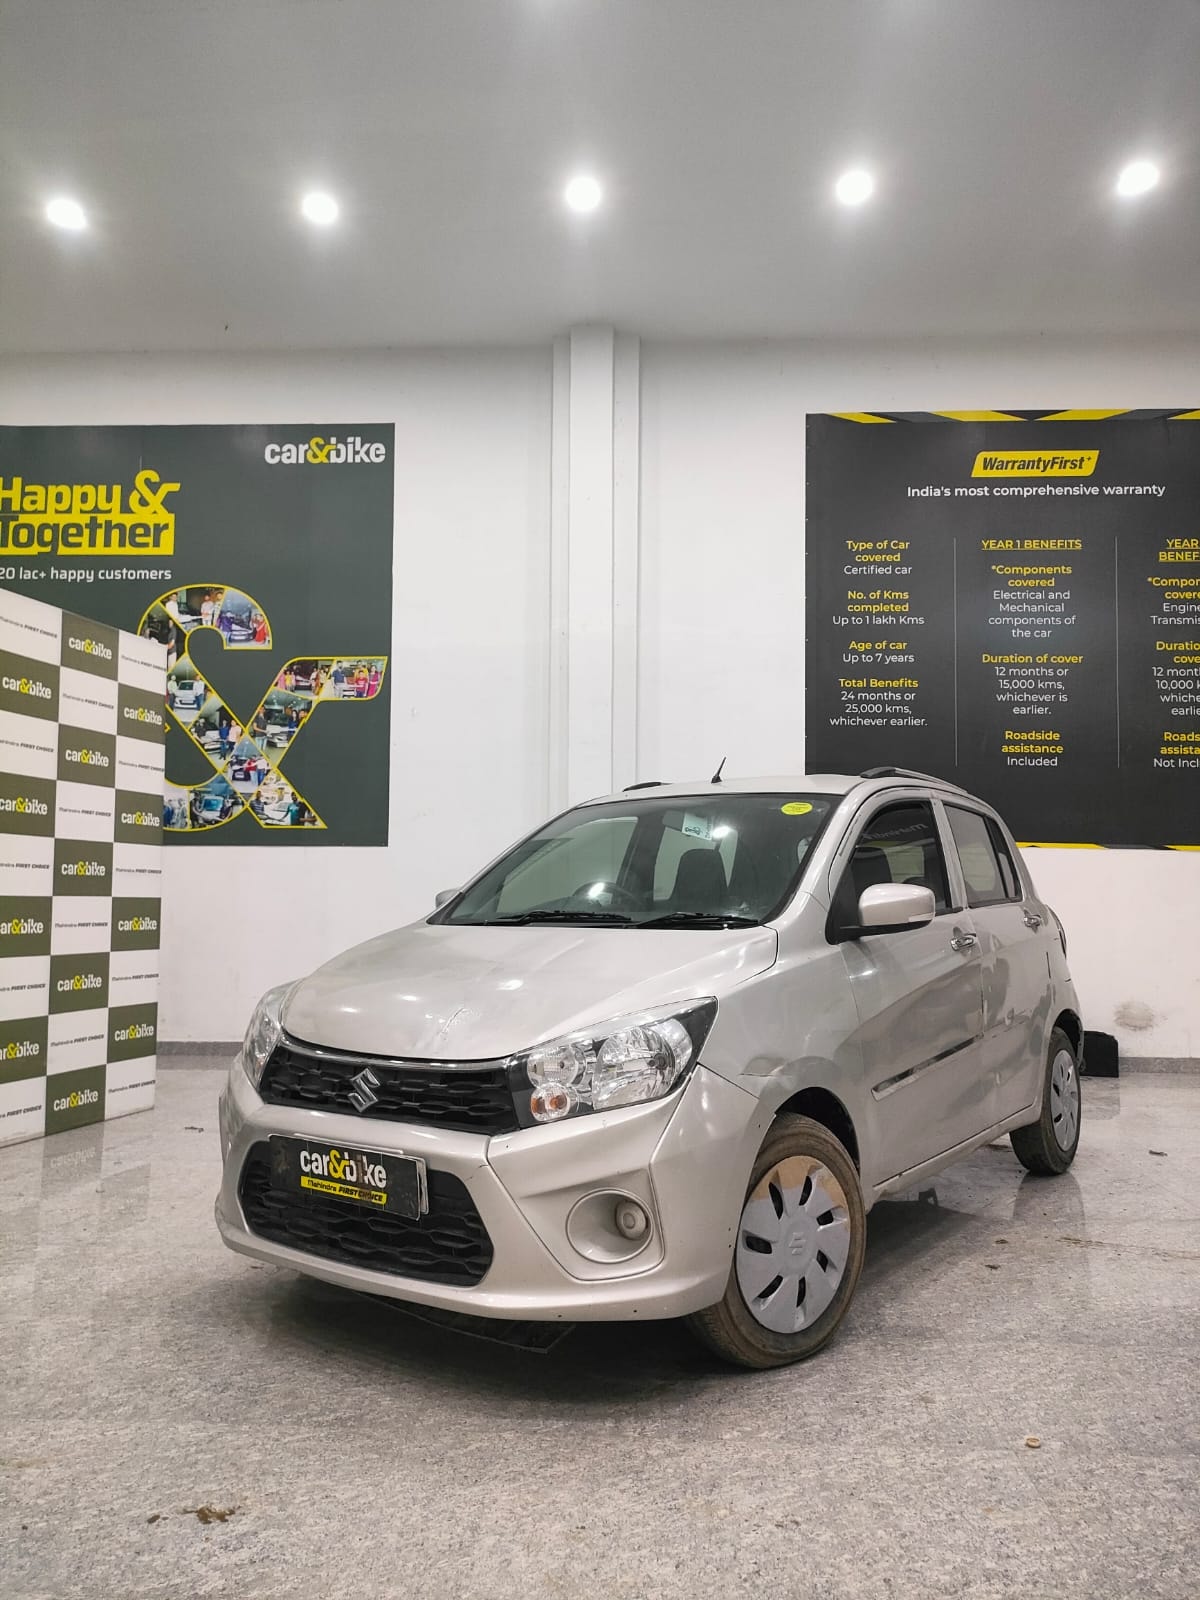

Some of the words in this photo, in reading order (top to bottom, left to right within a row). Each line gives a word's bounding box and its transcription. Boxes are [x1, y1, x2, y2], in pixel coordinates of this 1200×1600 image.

[264, 436, 386, 465] car&bike
[0, 476, 122, 514] Happy
[129, 469, 181, 514] &
[907, 485, 952, 497] India's
[954, 486, 990, 497] most
[992, 483, 1100, 498] comprehensive
[1102, 484, 1166, 497] warranty
[0, 516, 169, 555] Together
[846, 540, 873, 552] Type
[876, 540, 888, 550] of
[890, 539, 911, 550] Car
[981, 539, 1014, 549] YEAR
[1023, 539, 1082, 549] BENEFITS
[1166, 538, 1199, 549] YEAR
[855, 552, 901, 562] covered
[19, 566, 47, 580] lac+
[51, 566, 94, 582] happy
[98, 567, 172, 580] customers
[843, 564, 892, 575] Certified
[894, 566, 913, 575] car
[1007, 577, 1055, 587] covered
[847, 590, 866, 600] No.
[869, 590, 880, 600] of
[883, 590, 909, 600] Kms
[993, 589, 1045, 600] Electrical
[1047, 590, 1071, 600] and
[847, 602, 909, 614] completed
[999, 602, 1065, 613] Mechanical
[832, 615, 849, 627] Up
[851, 616, 863, 625] to
[872, 614, 896, 625] lakh
[899, 615, 925, 625] Kms
[988, 616, 1062, 627] components
[1063, 615, 1077, 625] of
[1011, 627, 1032, 638] the
[1033, 630, 1053, 638] car
[68, 637, 113, 660] car&bike
[848, 640, 872, 652] Age
[875, 640, 886, 650] of
[889, 642, 907, 650] car
[1155, 640, 1200, 651] Duratio
[842, 653, 859, 664] Up
[861, 653, 874, 663] to
[875, 653, 882, 663] 7
[884, 654, 915, 665] years
[982, 653, 1033, 664] Duration
[1035, 653, 1048, 664] of
[1050, 655, 1084, 664] cover
[1173, 654, 1200, 664] cove
[994, 666, 1006, 676] 12
[1008, 666, 1055, 677] months
[1056, 668, 1070, 677] or
[1151, 666, 1164, 677] 12
[2, 676, 52, 699] car&bike
[838, 677, 867, 688] Total
[869, 677, 919, 688] Benefits
[998, 679, 1035, 690] 15,000
[1037, 679, 1065, 691] kms,
[1155, 679, 1194, 690] 10,000
[840, 690, 856, 701] 24
[857, 690, 902, 701] months
[903, 692, 916, 701] or
[995, 691, 1057, 702] whichever
[1059, 692, 1068, 702] is
[845, 703, 883, 714] 25,000
[885, 703, 912, 715] kms,
[1012, 704, 1052, 715] earlier.
[123, 706, 163, 725] car&bike
[829, 715, 888, 726] whichever
[889, 716, 928, 726] earlier.
[1005, 730, 1061, 741] Roadside
[1163, 731, 1200, 742] Roads
[1001, 742, 1064, 754] assistance
[1160, 744, 1200, 755] assista
[65, 748, 109, 767] car&bike
[1007, 756, 1058, 767] Included
[1153, 757, 1176, 768] Not
[1178, 757, 1200, 768] Incl
[121, 811, 160, 827] car&bike
[61, 860, 106, 876] car&bike
[0, 918, 44, 935] ar&bike
[118, 916, 157, 931] car&bike
[57, 973, 102, 991] car&bike
[114, 1023, 154, 1041] car&bike
[0, 1040, 40, 1060] r&bike
[53, 1088, 99, 1111] car&bike
[300, 1149, 387, 1189] car&bike
[338, 1186, 358, 1197] FIRST
